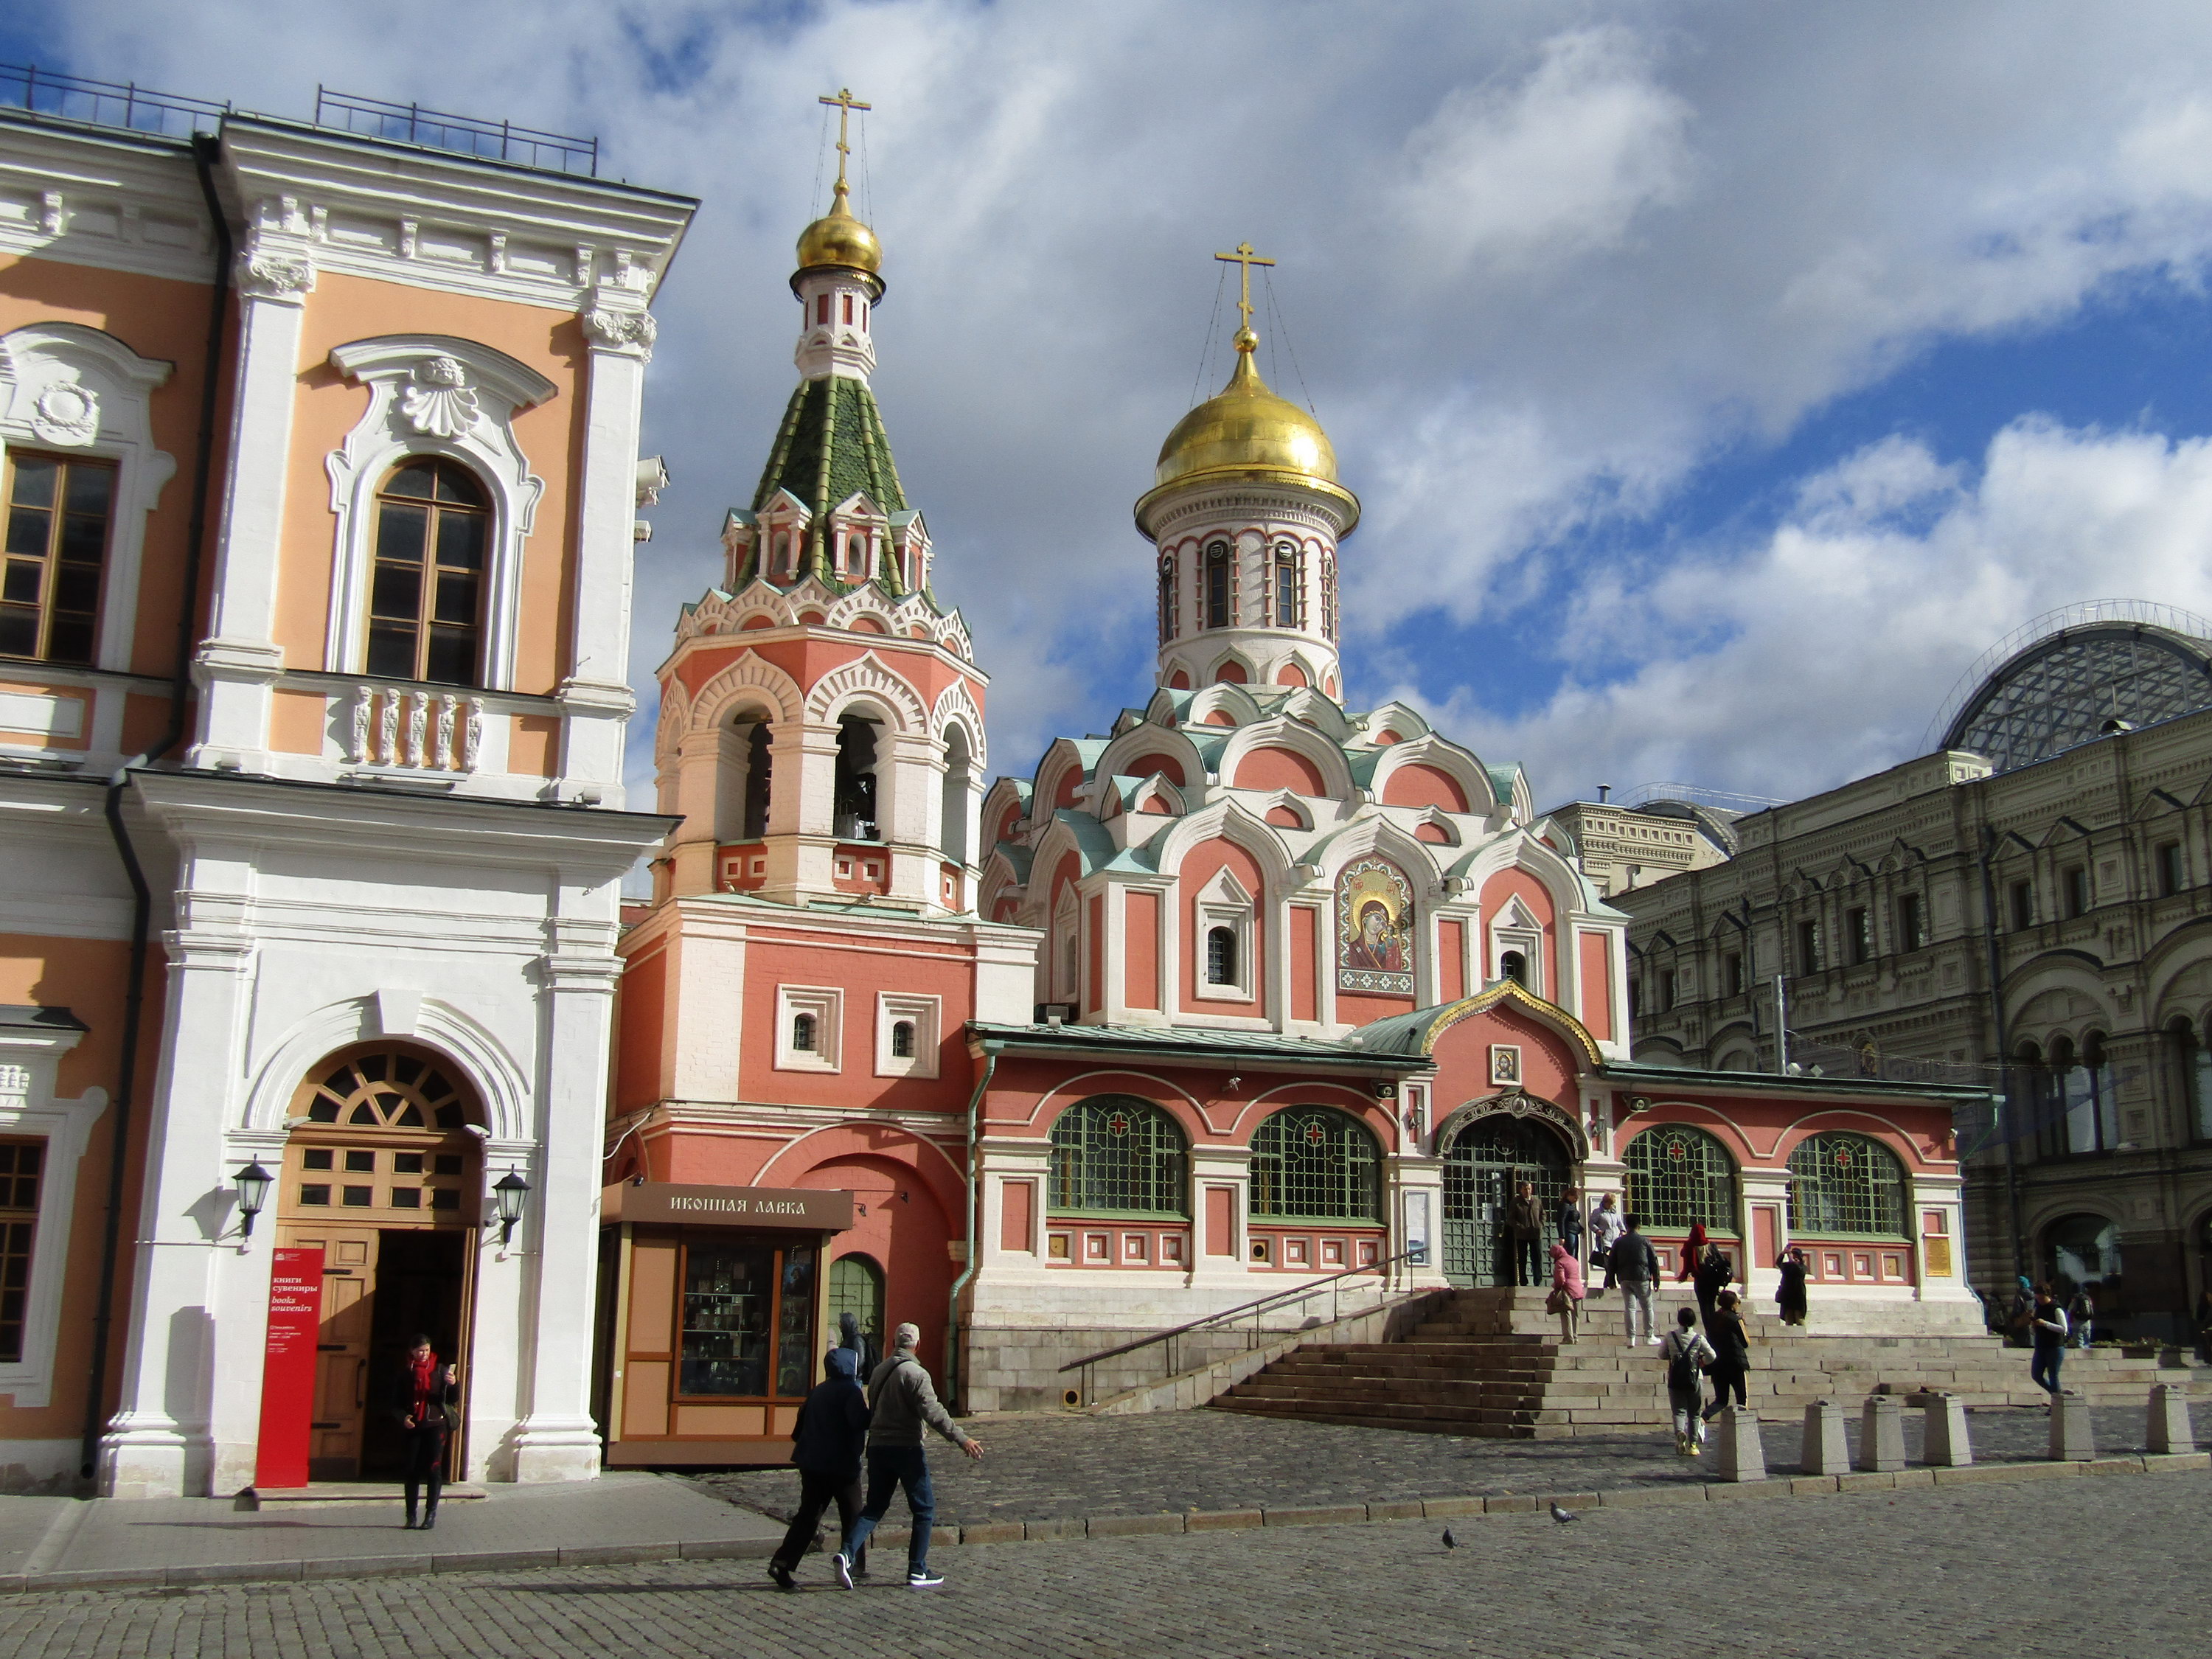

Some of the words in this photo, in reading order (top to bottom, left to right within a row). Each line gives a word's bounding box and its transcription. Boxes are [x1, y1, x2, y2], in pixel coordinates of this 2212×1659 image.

[670, 1197, 748, 1212] ИКОННАЯ
[755, 1200, 806, 1215] ЛАВКА
[273, 1285, 317, 1293] сувениры
